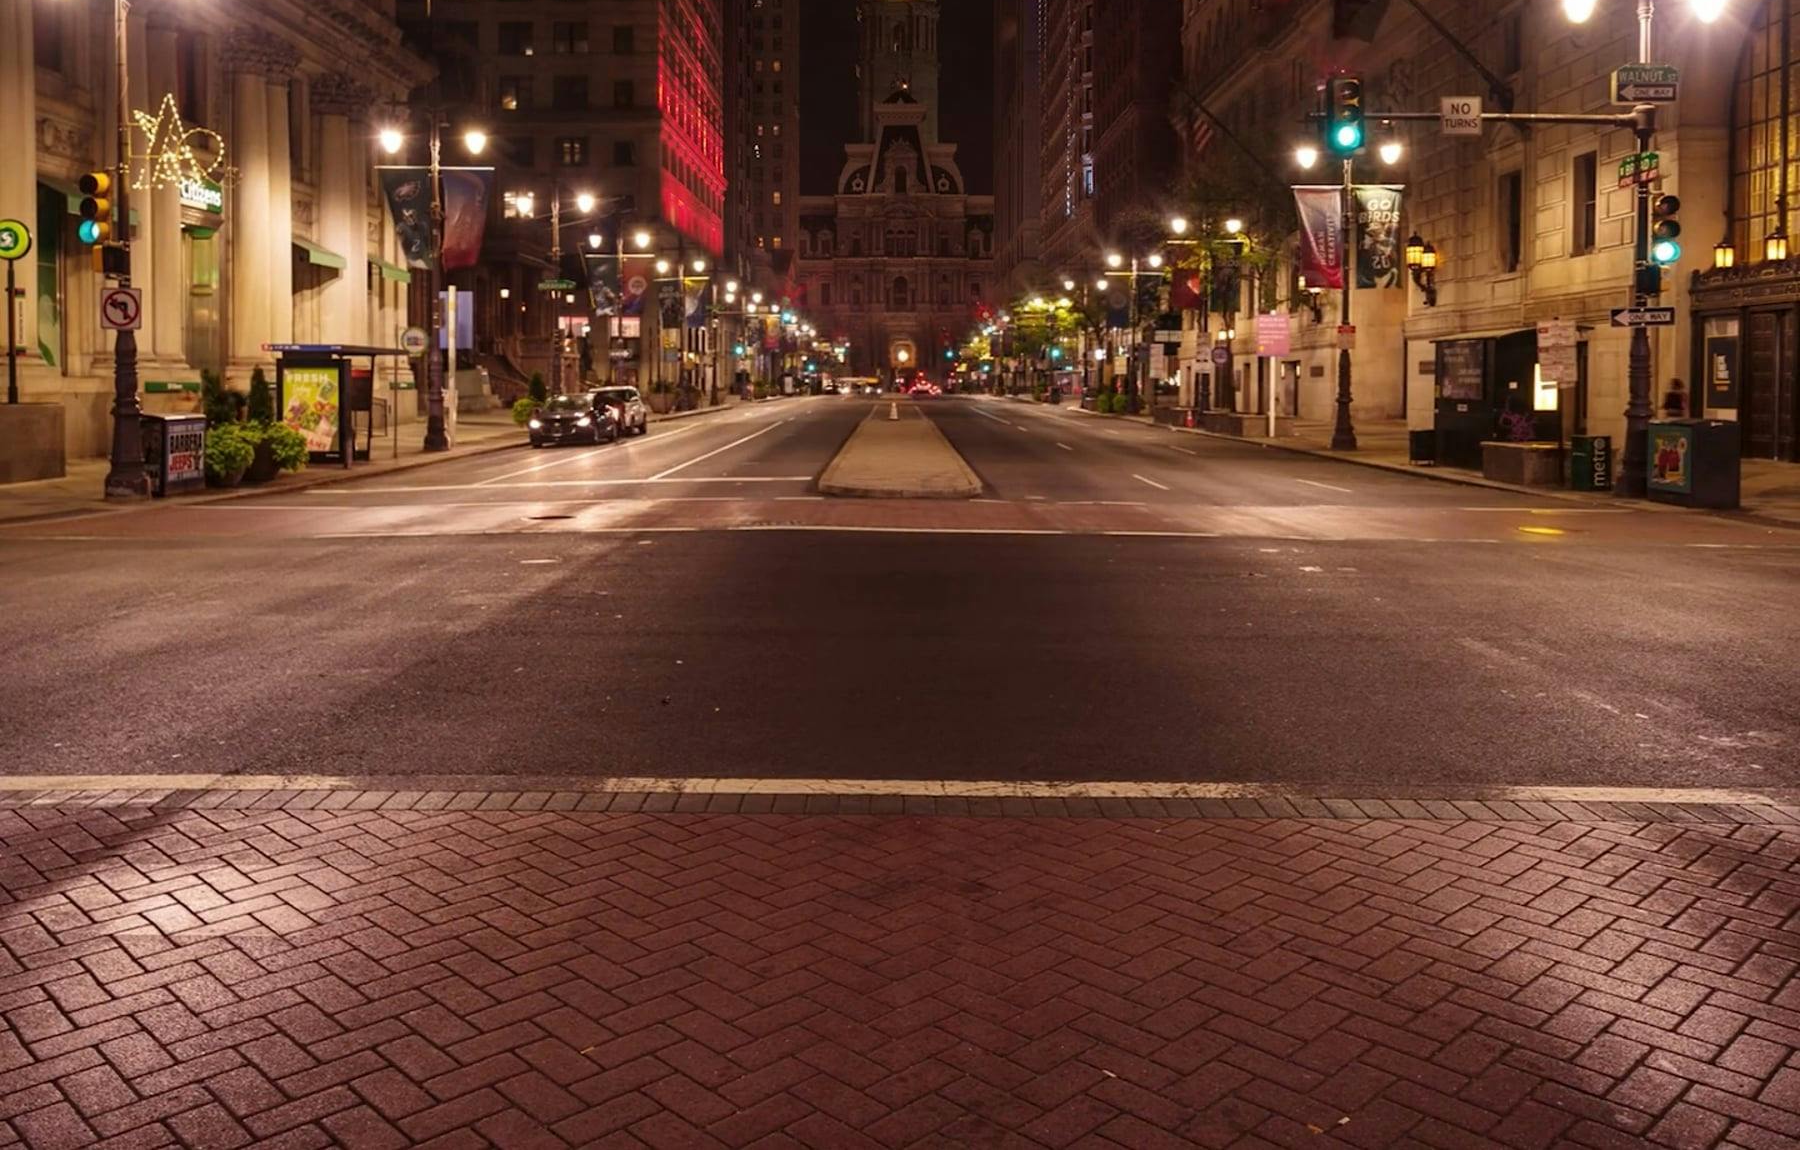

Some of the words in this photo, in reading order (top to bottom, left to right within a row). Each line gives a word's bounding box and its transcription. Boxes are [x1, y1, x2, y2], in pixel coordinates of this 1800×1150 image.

[1619, 70, 1664, 82] WALNUT
[1634, 88, 1649, 97] ONE
[1654, 88, 1672, 97] WAY
[1451, 103, 1471, 115] NO
[1445, 118, 1478, 129] TURNS
[1367, 199, 1392, 211] GO
[1358, 211, 1400, 223] BIRDS
[1628, 312, 1646, 321] ONE
[1649, 312, 1669, 321] WAY
[1593, 438, 1606, 487] metro
